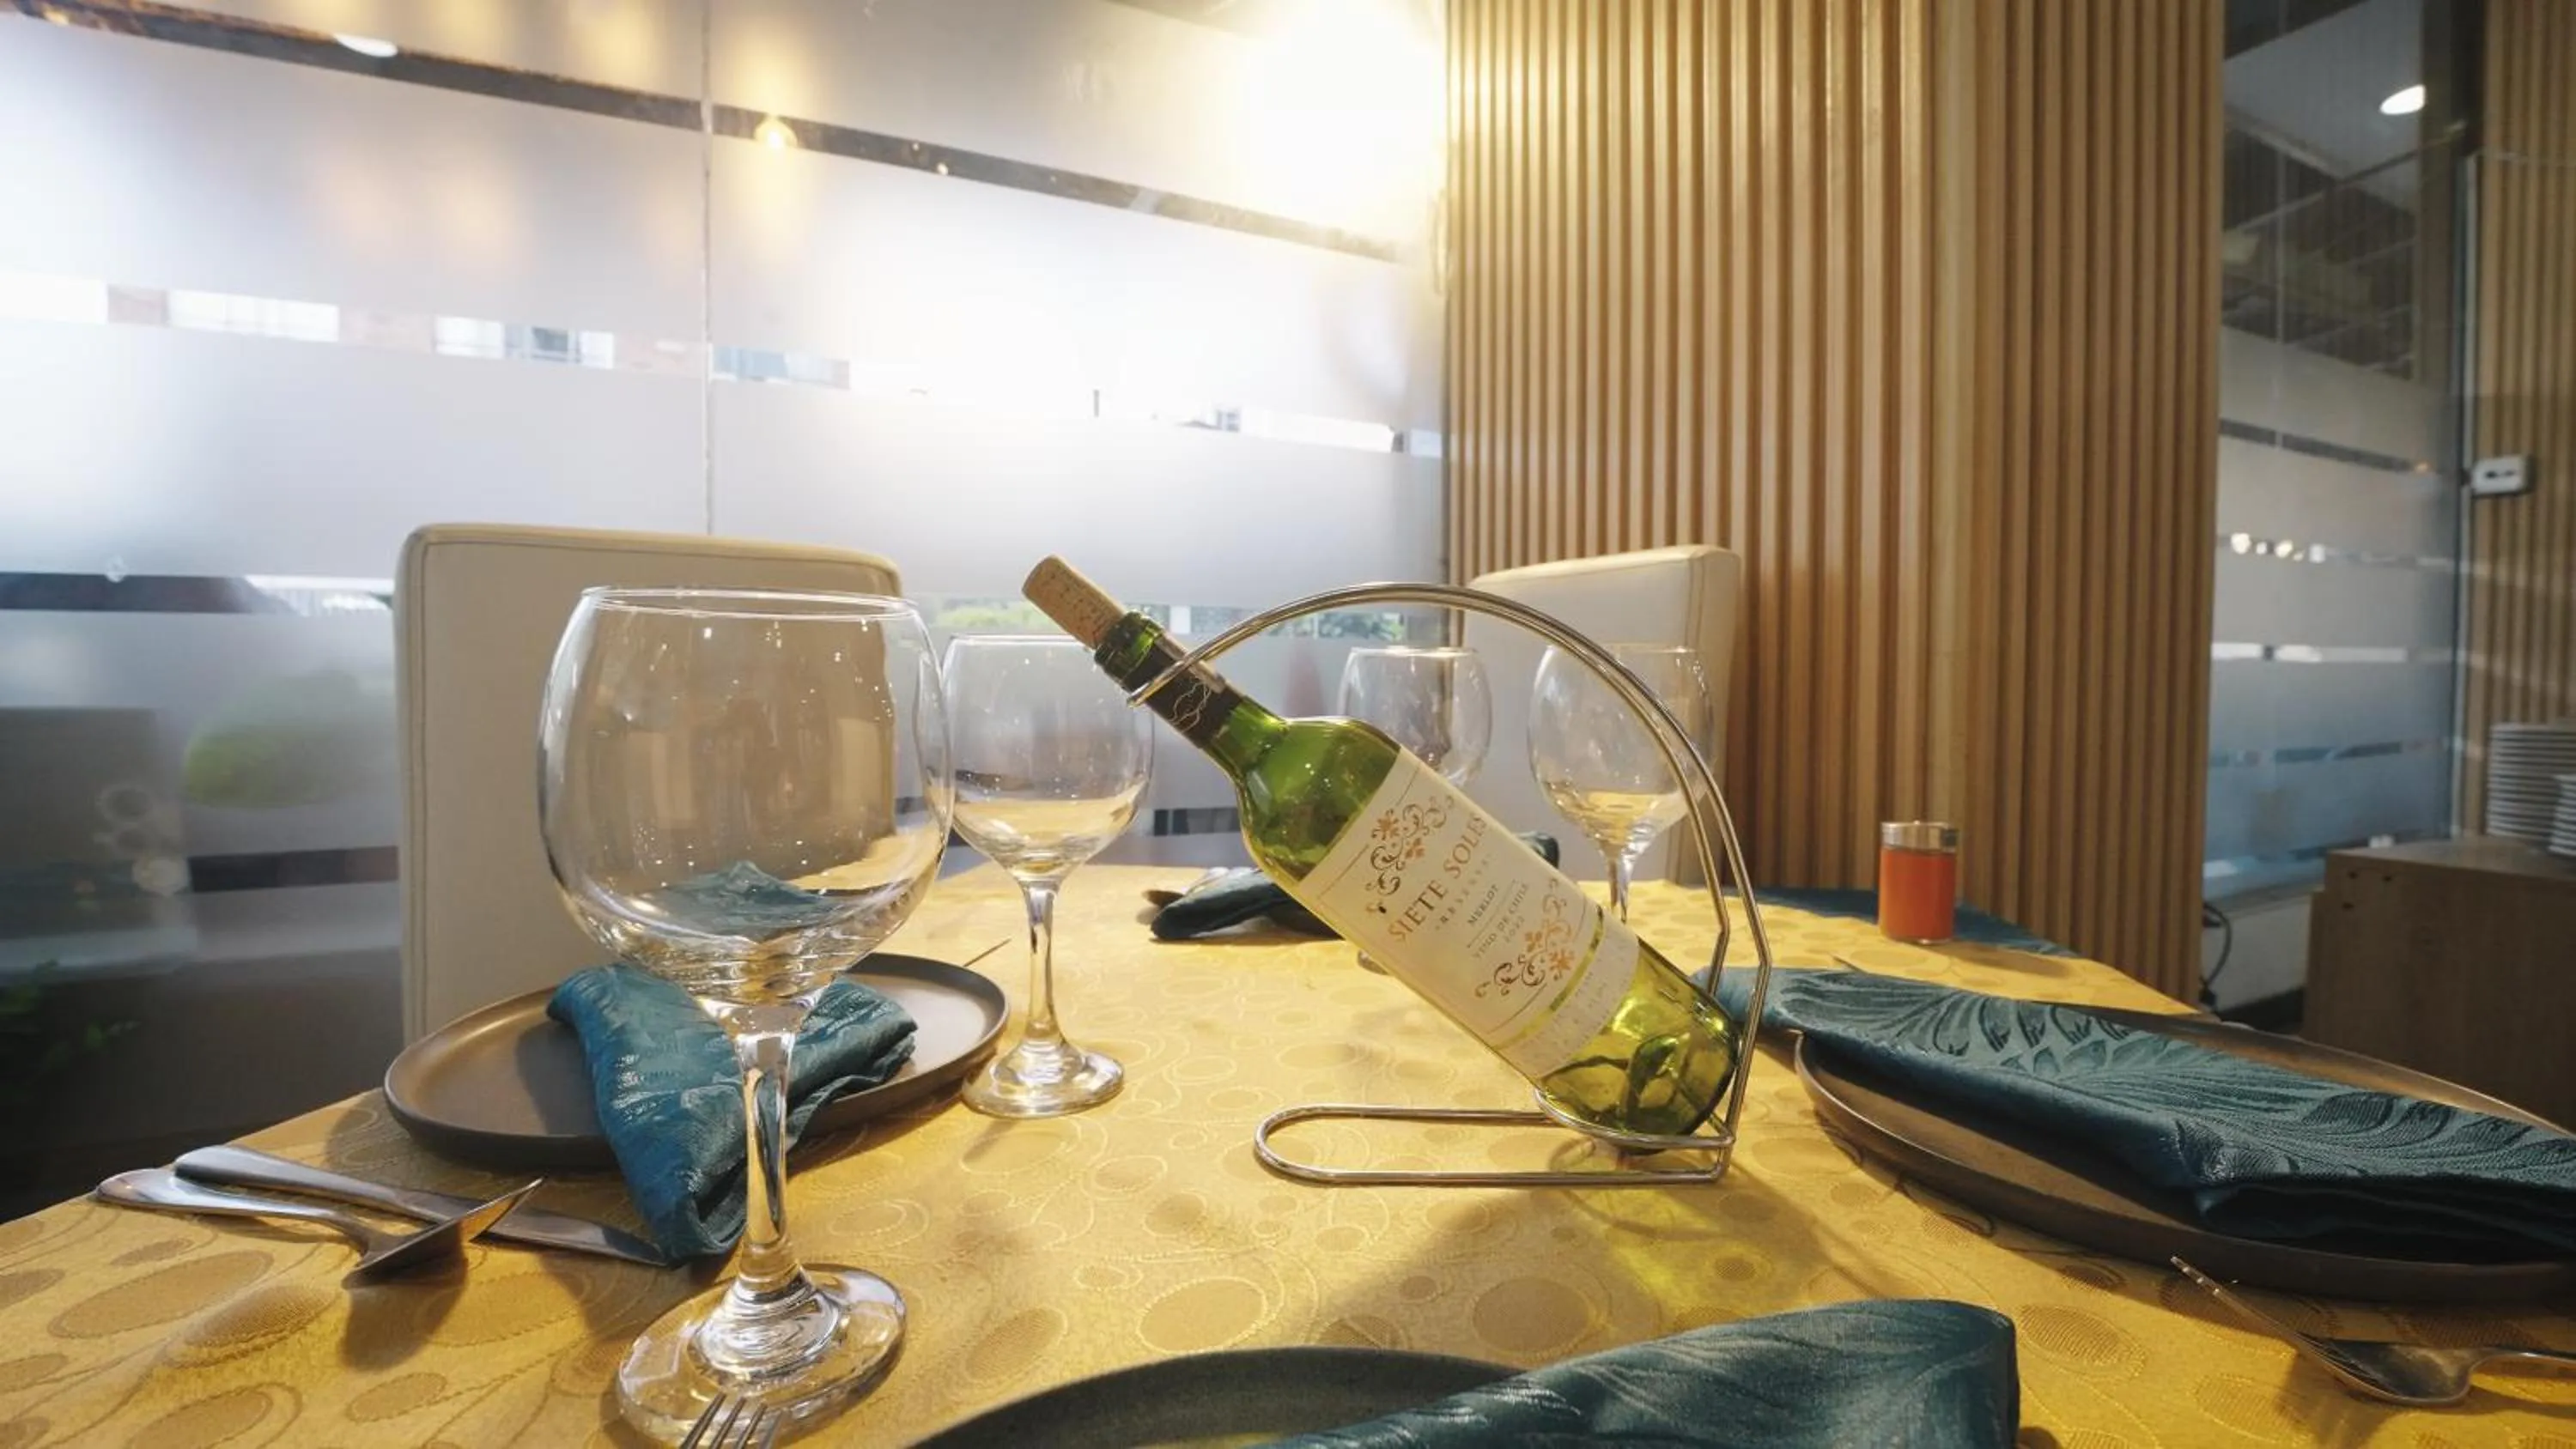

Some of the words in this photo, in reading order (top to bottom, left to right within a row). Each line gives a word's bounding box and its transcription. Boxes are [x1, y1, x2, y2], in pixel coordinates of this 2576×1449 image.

[1388, 879, 1449, 943] SIETE
[1443, 815, 1487, 880] SOLES
[1466, 884, 1499, 925] MERLOT
